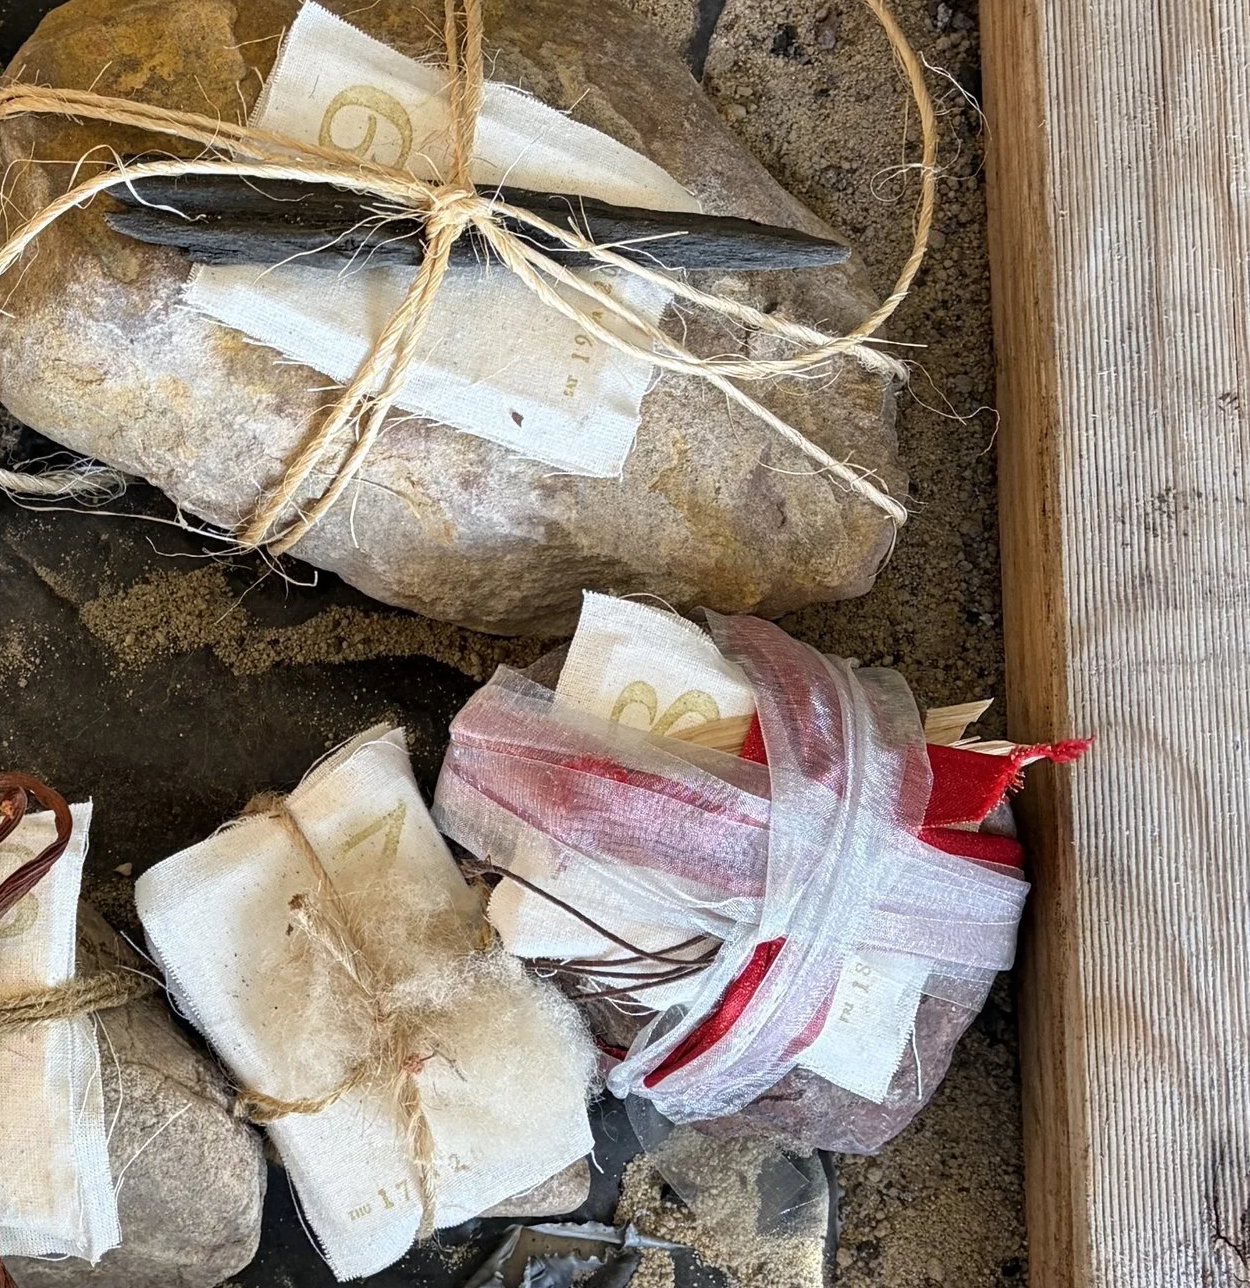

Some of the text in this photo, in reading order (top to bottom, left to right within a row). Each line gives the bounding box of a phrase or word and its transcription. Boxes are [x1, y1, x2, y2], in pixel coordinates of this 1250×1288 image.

[563, 374, 579, 398] SAT
[571, 334, 593, 364] 19
[348, 1203, 371, 1221] THU
[377, 1178, 410, 1209] 17
